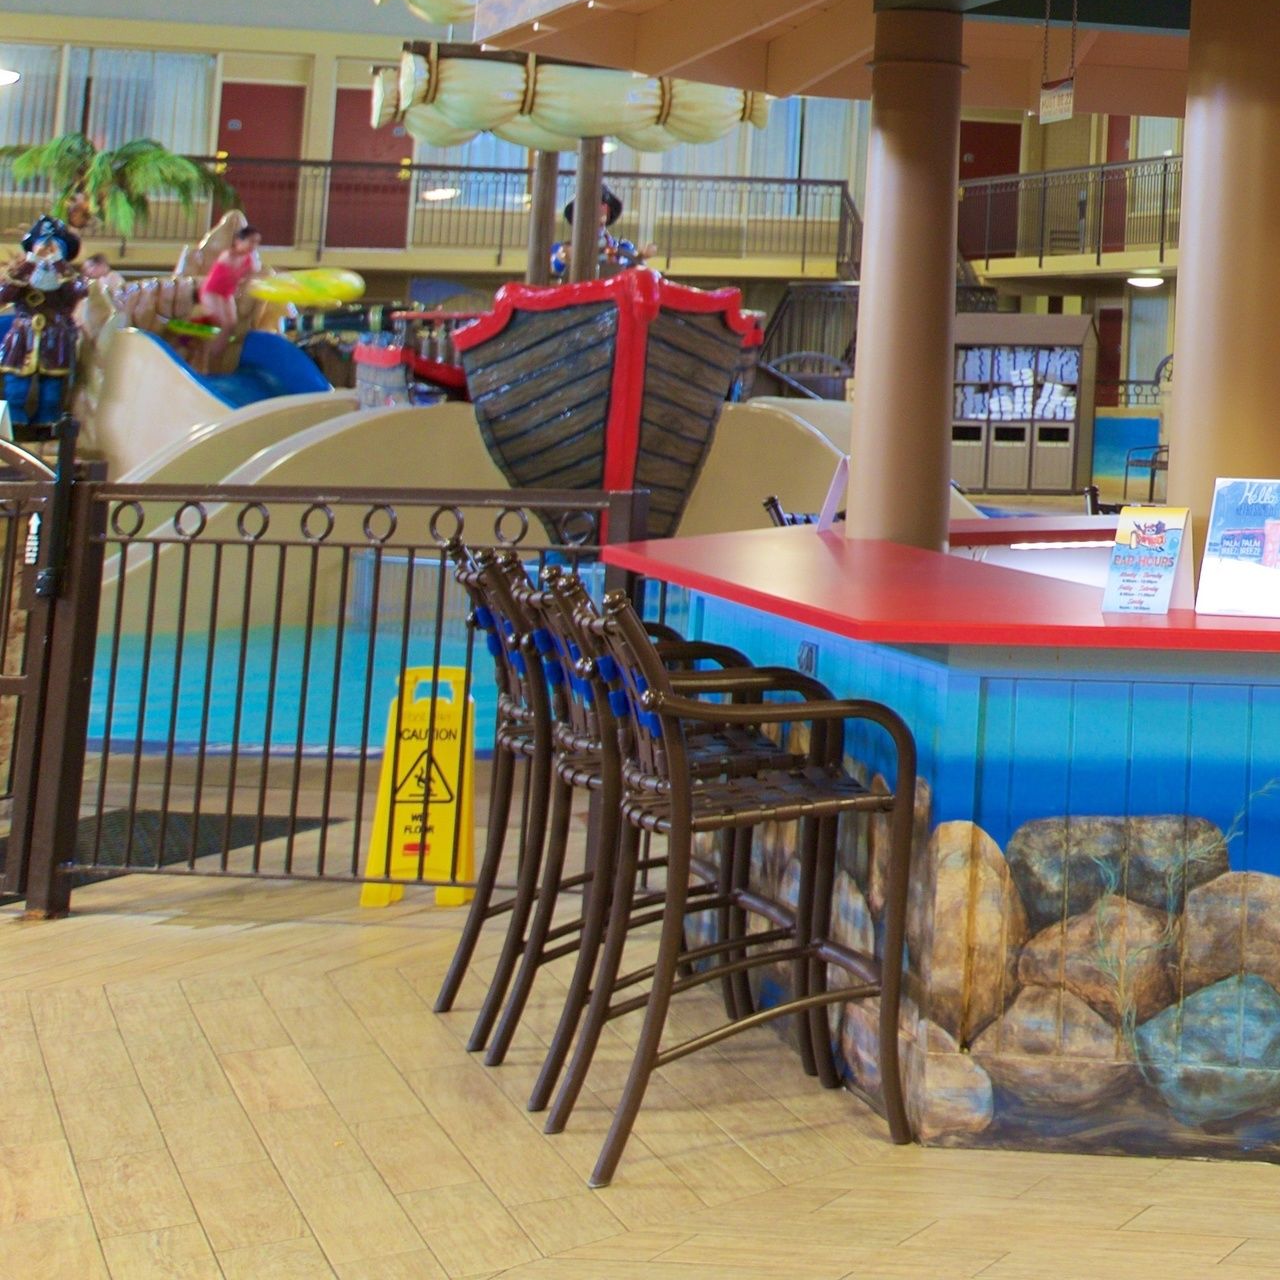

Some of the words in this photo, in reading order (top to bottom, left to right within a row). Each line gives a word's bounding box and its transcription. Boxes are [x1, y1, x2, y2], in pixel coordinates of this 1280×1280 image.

[1241, 539, 1261, 547] PALM
[1139, 555, 1175, 568] HOURS
[401, 728, 457, 740] CAUION
[404, 825, 434, 833] FLOR
